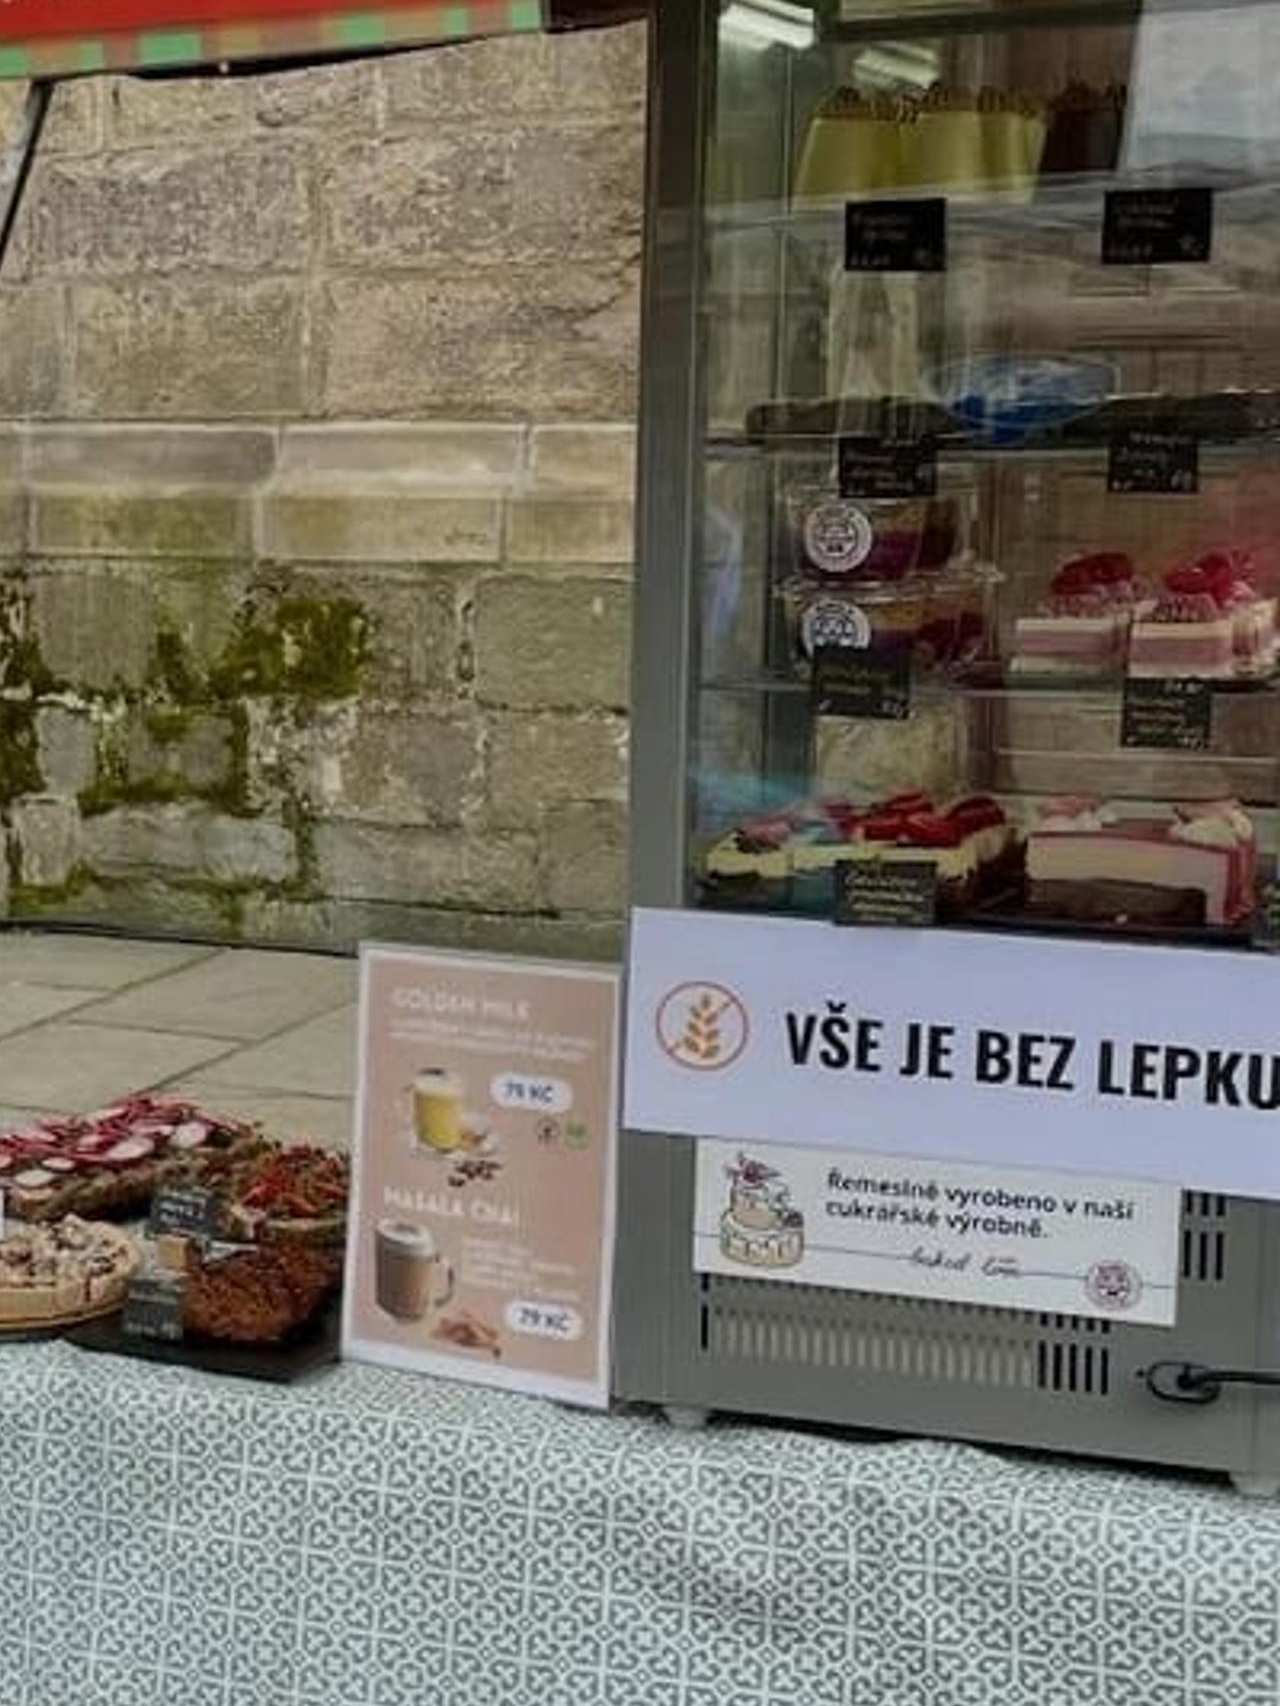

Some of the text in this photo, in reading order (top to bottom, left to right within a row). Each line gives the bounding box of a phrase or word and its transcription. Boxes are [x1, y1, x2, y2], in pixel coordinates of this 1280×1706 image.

[784, 999, 1280, 1111] VŠE JE BEZ LEPKU
[943, 1187, 1058, 1214] vyrobeno
[1061, 1200, 1077, 1215] v
